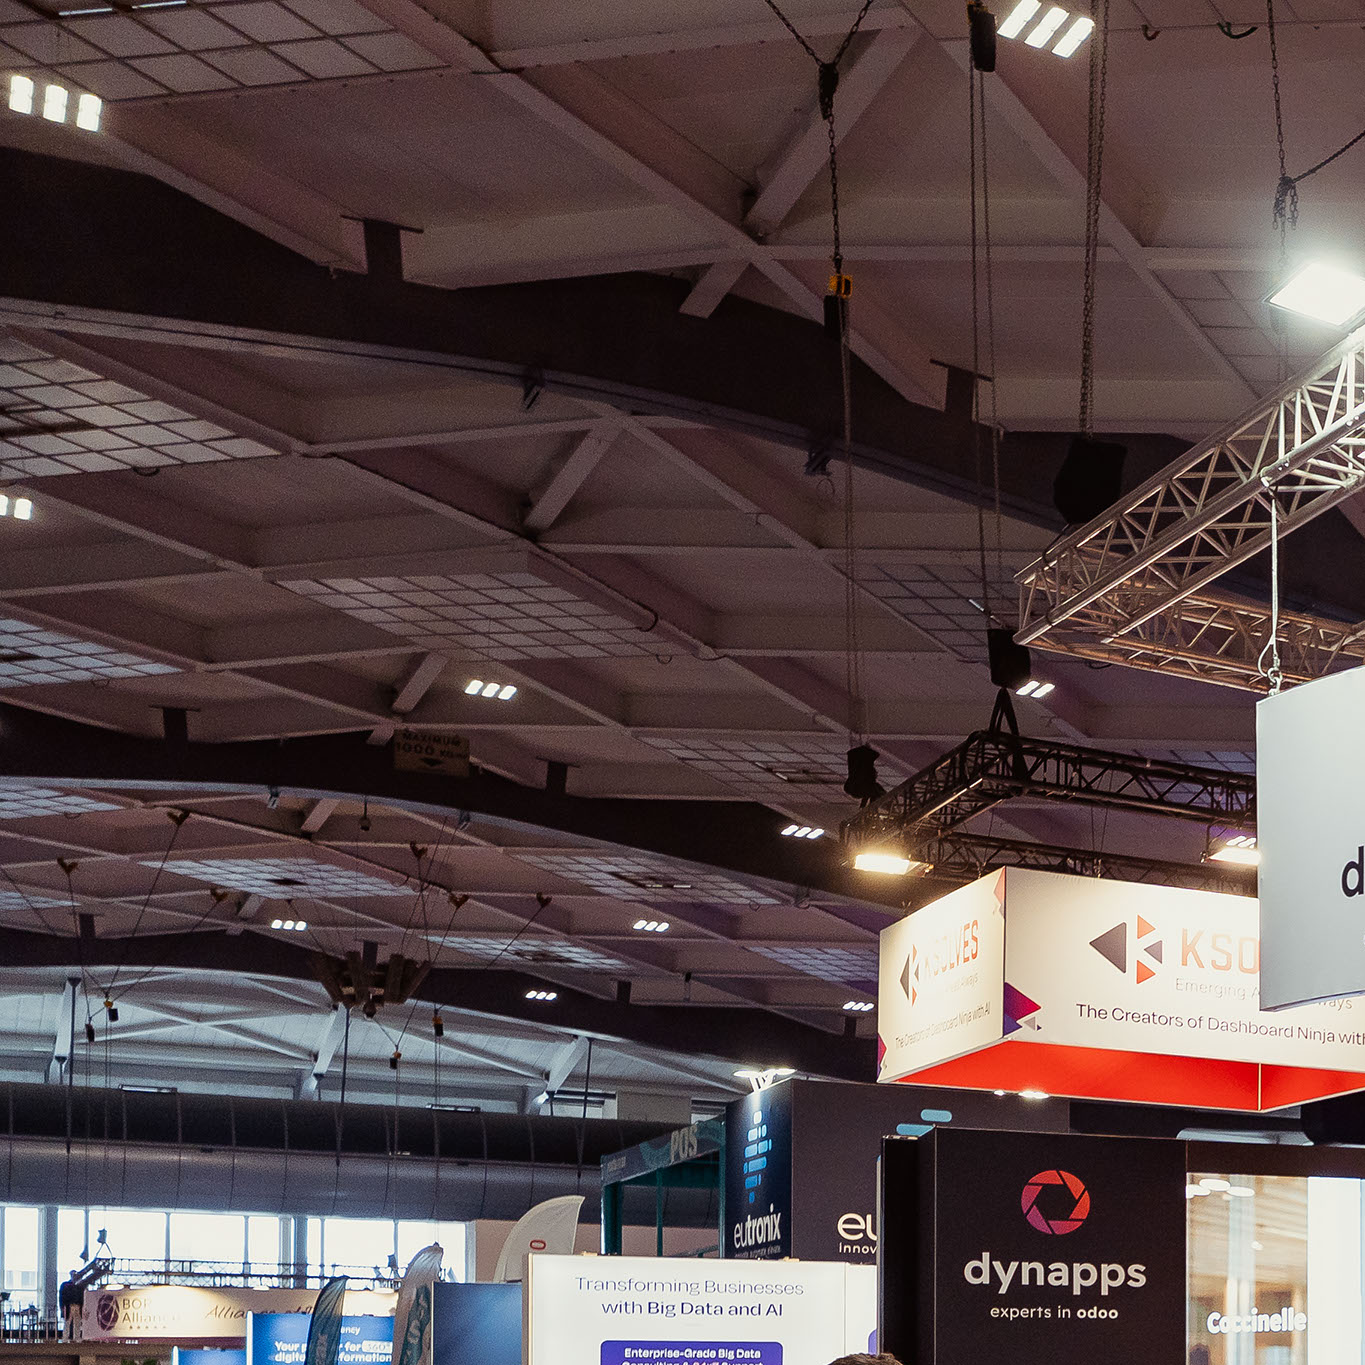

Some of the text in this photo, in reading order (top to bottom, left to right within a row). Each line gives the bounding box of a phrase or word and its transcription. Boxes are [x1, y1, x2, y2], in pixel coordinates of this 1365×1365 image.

[1175, 977, 1241, 1000] Emerging
[1076, 1003, 1108, 1020] The
[1111, 1006, 1184, 1028] Creators
[1187, 1014, 1204, 1030] of
[1208, 1017, 1294, 1038] Dashboard
[1297, 1026, 1336, 1044] Ninja
[670, 1124, 698, 1163] POS
[733, 1203, 781, 1248] eutronix
[839, 1242, 877, 1254] Innov
[963, 1251, 1147, 1296] dynapps
[575, 1276, 804, 1296] Transforming Businesses
[601, 1300, 784, 1318] with Big Data and AI
[990, 1305, 1119, 1321] experts in odoo
[1206, 1306, 1307, 1335] Coccinelle
[274, 1340, 300, 1352] Your
[344, 1341, 361, 1352] for
[624, 1347, 761, 1361] Enterprise-Grade Big Data
